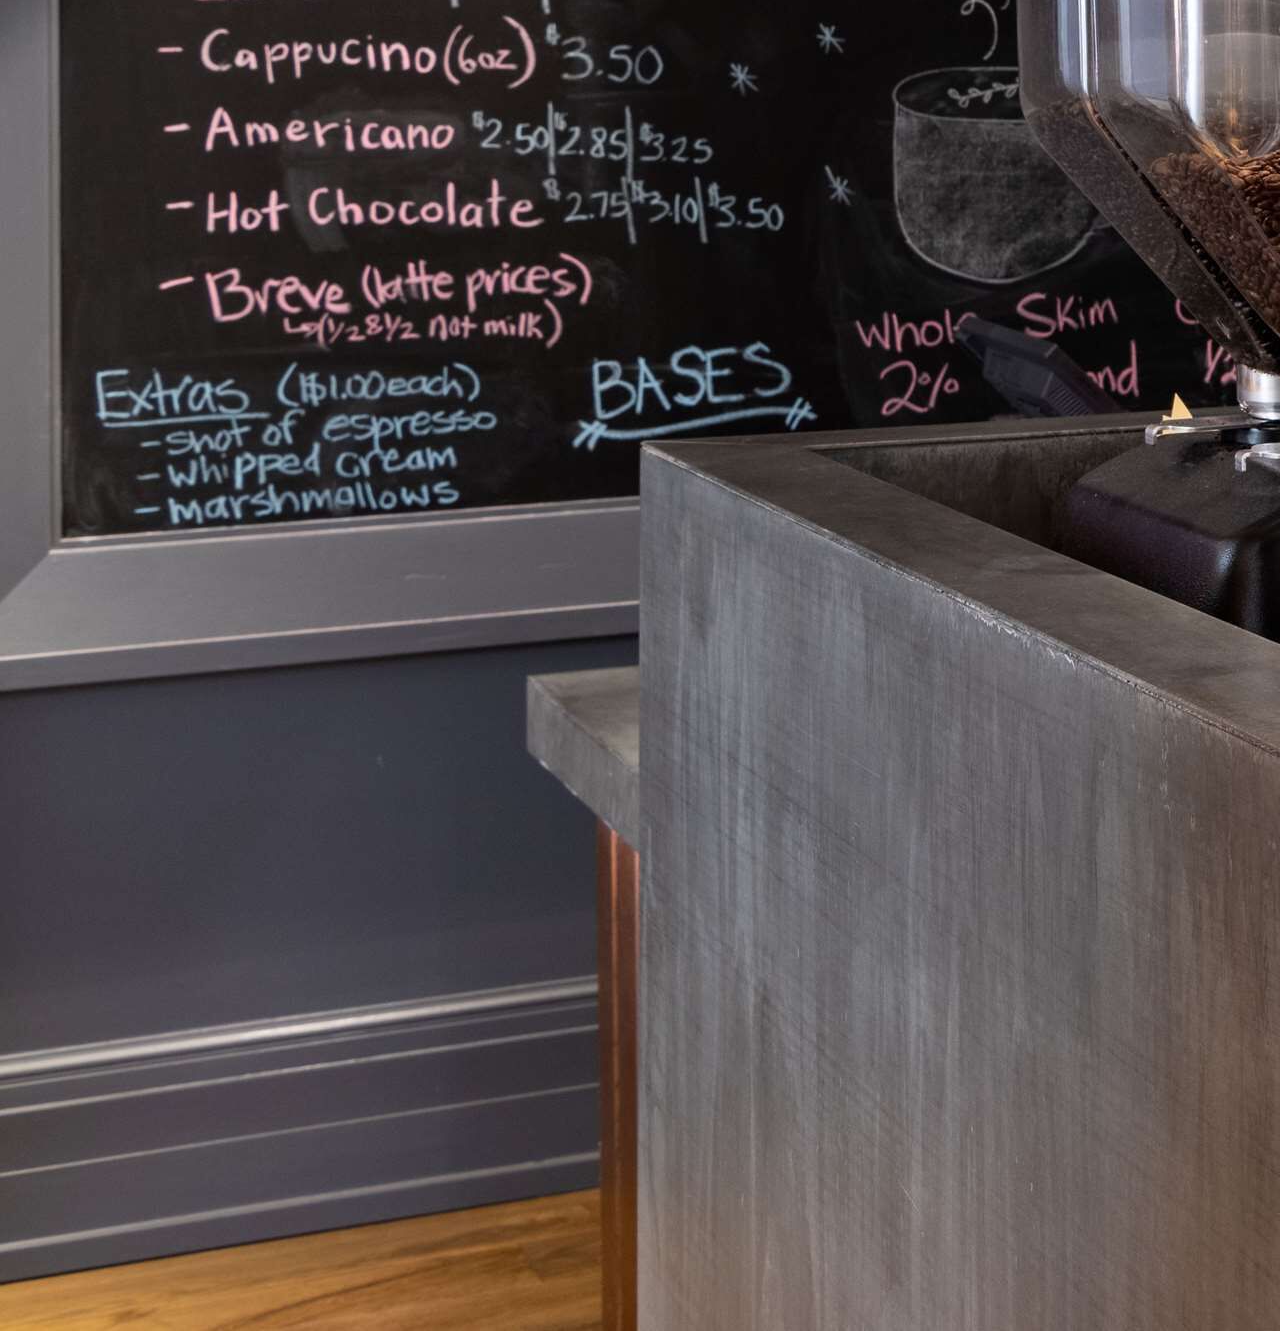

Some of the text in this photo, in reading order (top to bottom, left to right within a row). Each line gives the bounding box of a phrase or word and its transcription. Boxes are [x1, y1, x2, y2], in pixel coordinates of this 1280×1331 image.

[204, 107, 456, 152] Americano
[206, 189, 290, 233] Hot
[309, 181, 544, 228] Chocolate
[206, 268, 351, 323] Breve
[466, 253, 593, 313] prices)
[428, 314, 478, 341] not
[1016, 292, 1118, 338] Skim
[95, 368, 251, 419] Extras
[591, 342, 792, 420] BASES
[880, 360, 960, 416] 2%
[165, 409, 498, 456] shot of espresso
[168, 442, 458, 490] whipped cream
[168, 481, 460, 525] marshmallows
